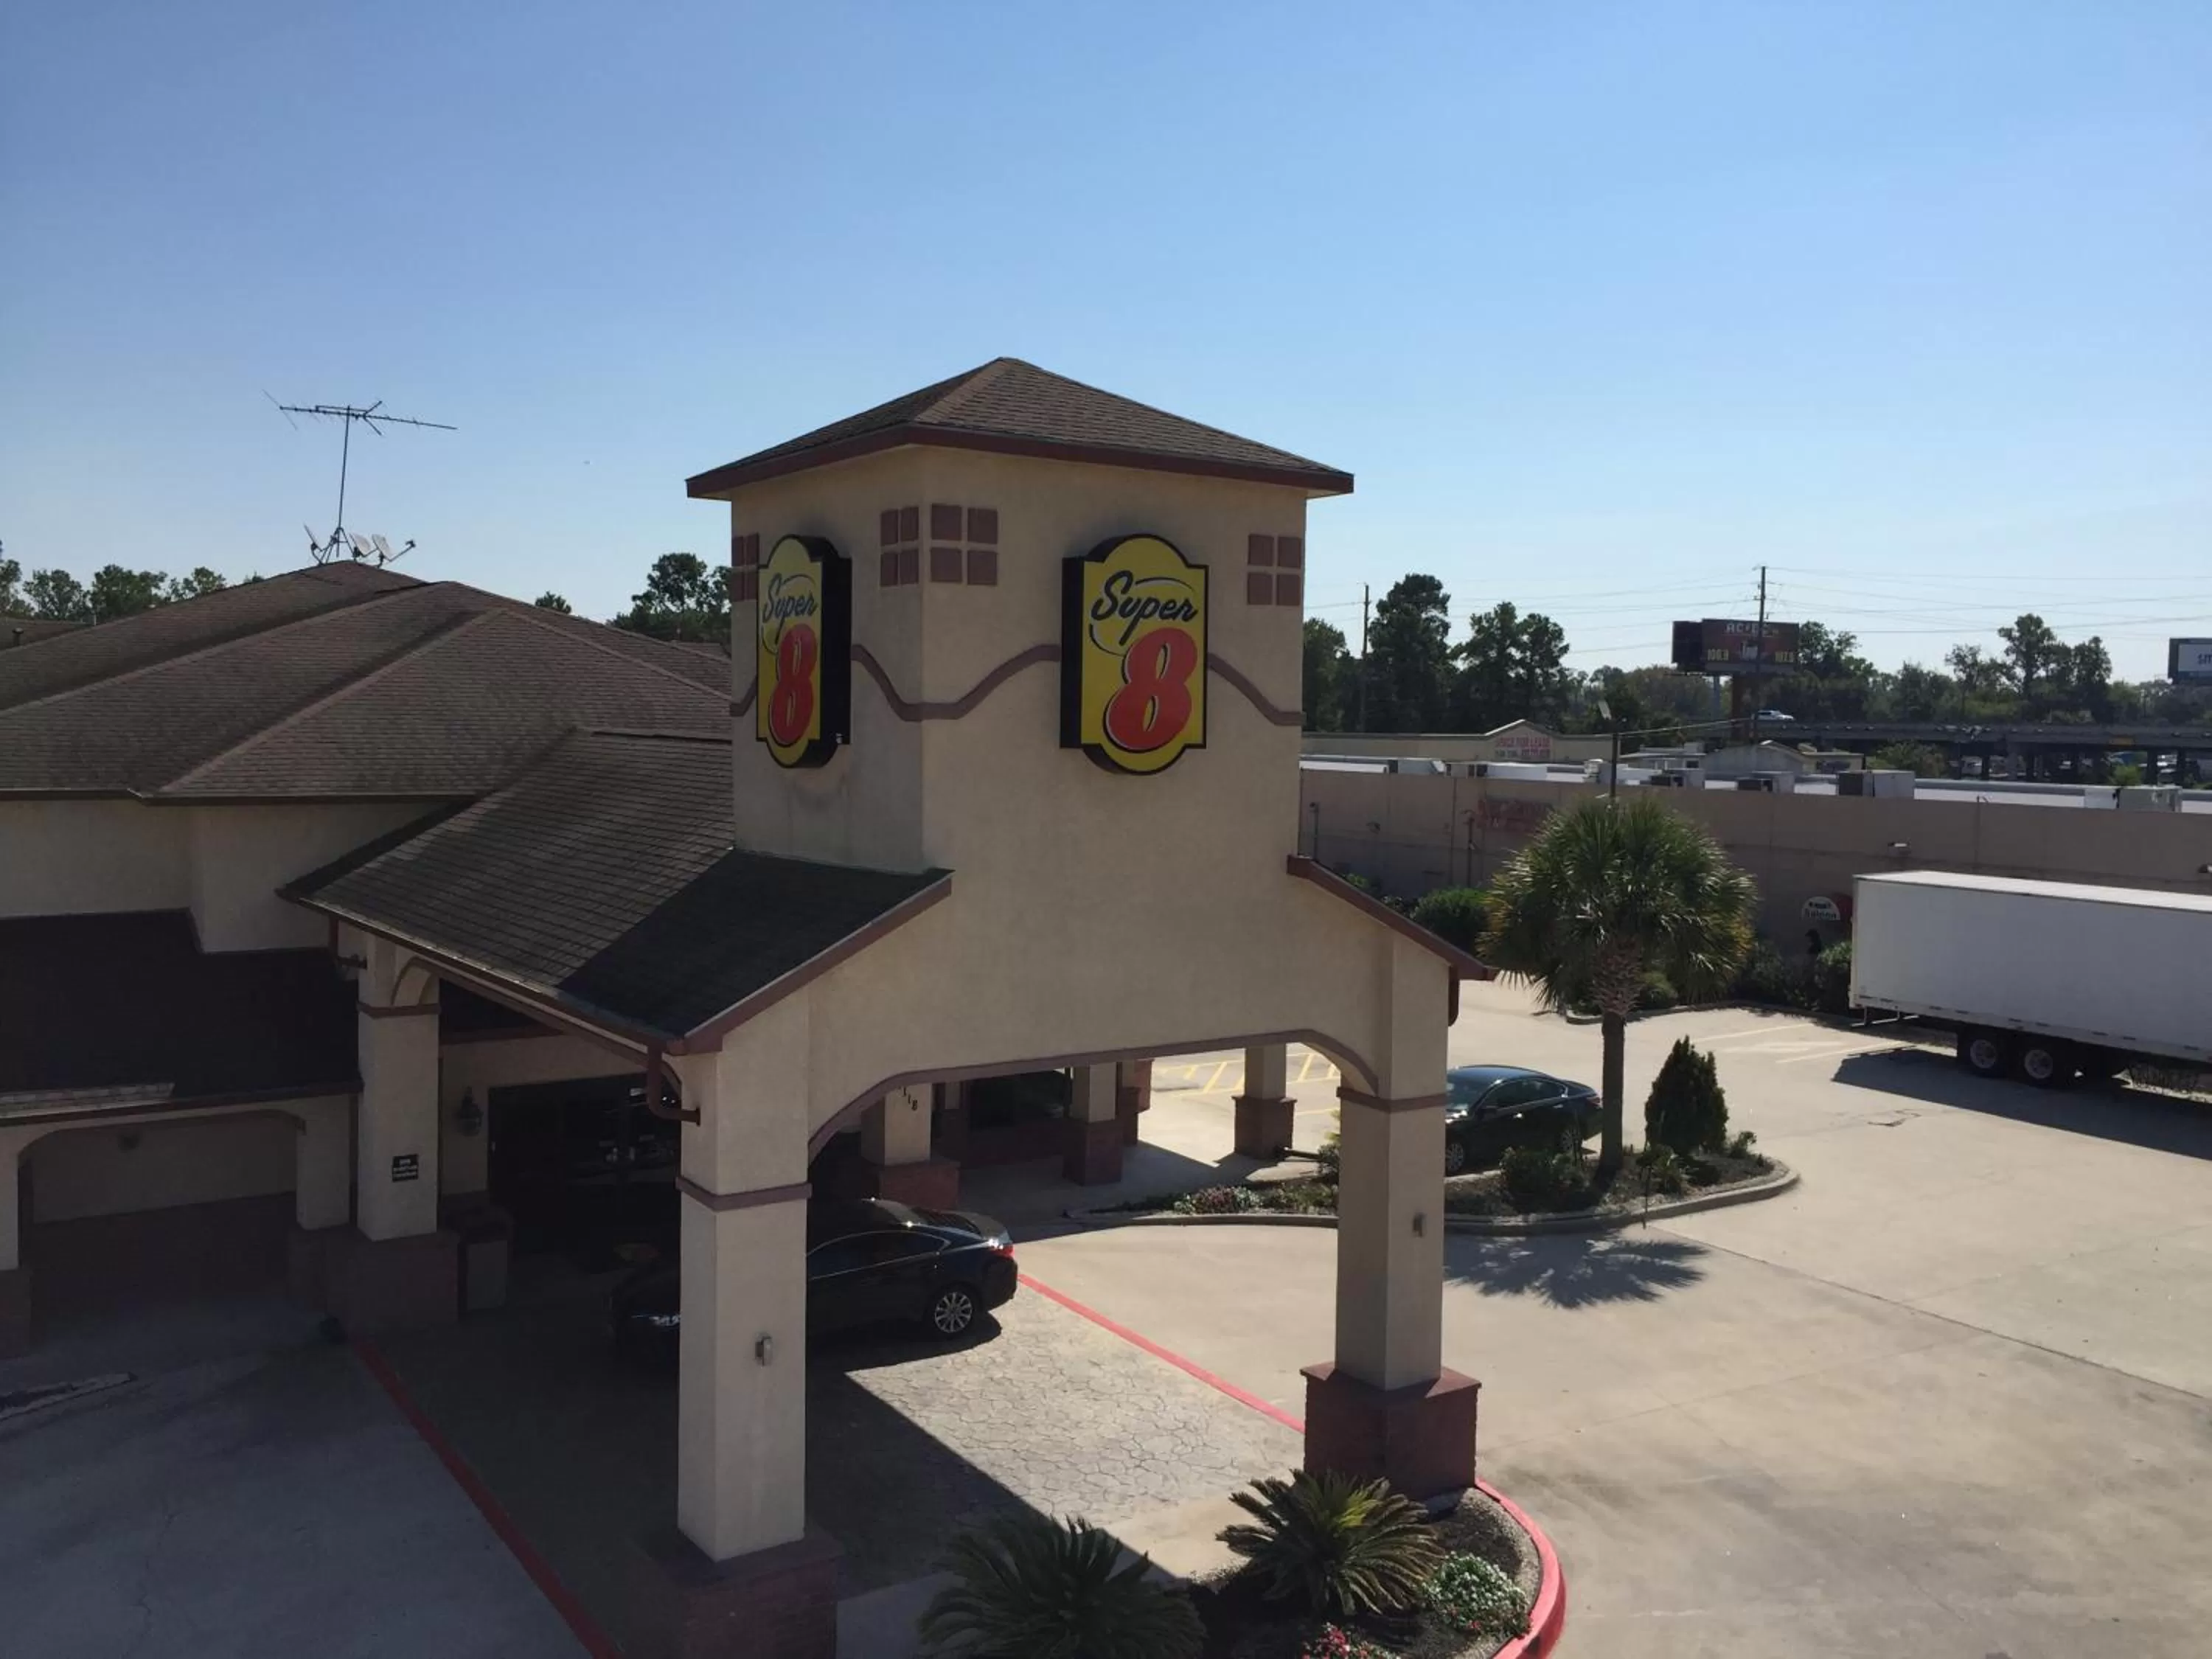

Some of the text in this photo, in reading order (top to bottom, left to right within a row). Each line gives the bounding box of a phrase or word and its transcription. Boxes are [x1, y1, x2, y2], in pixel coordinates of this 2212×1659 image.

[763, 572, 818, 643] Super
[1091, 571, 1197, 644] Super
[769, 624, 818, 747] 8
[1105, 627, 1198, 753] 8
